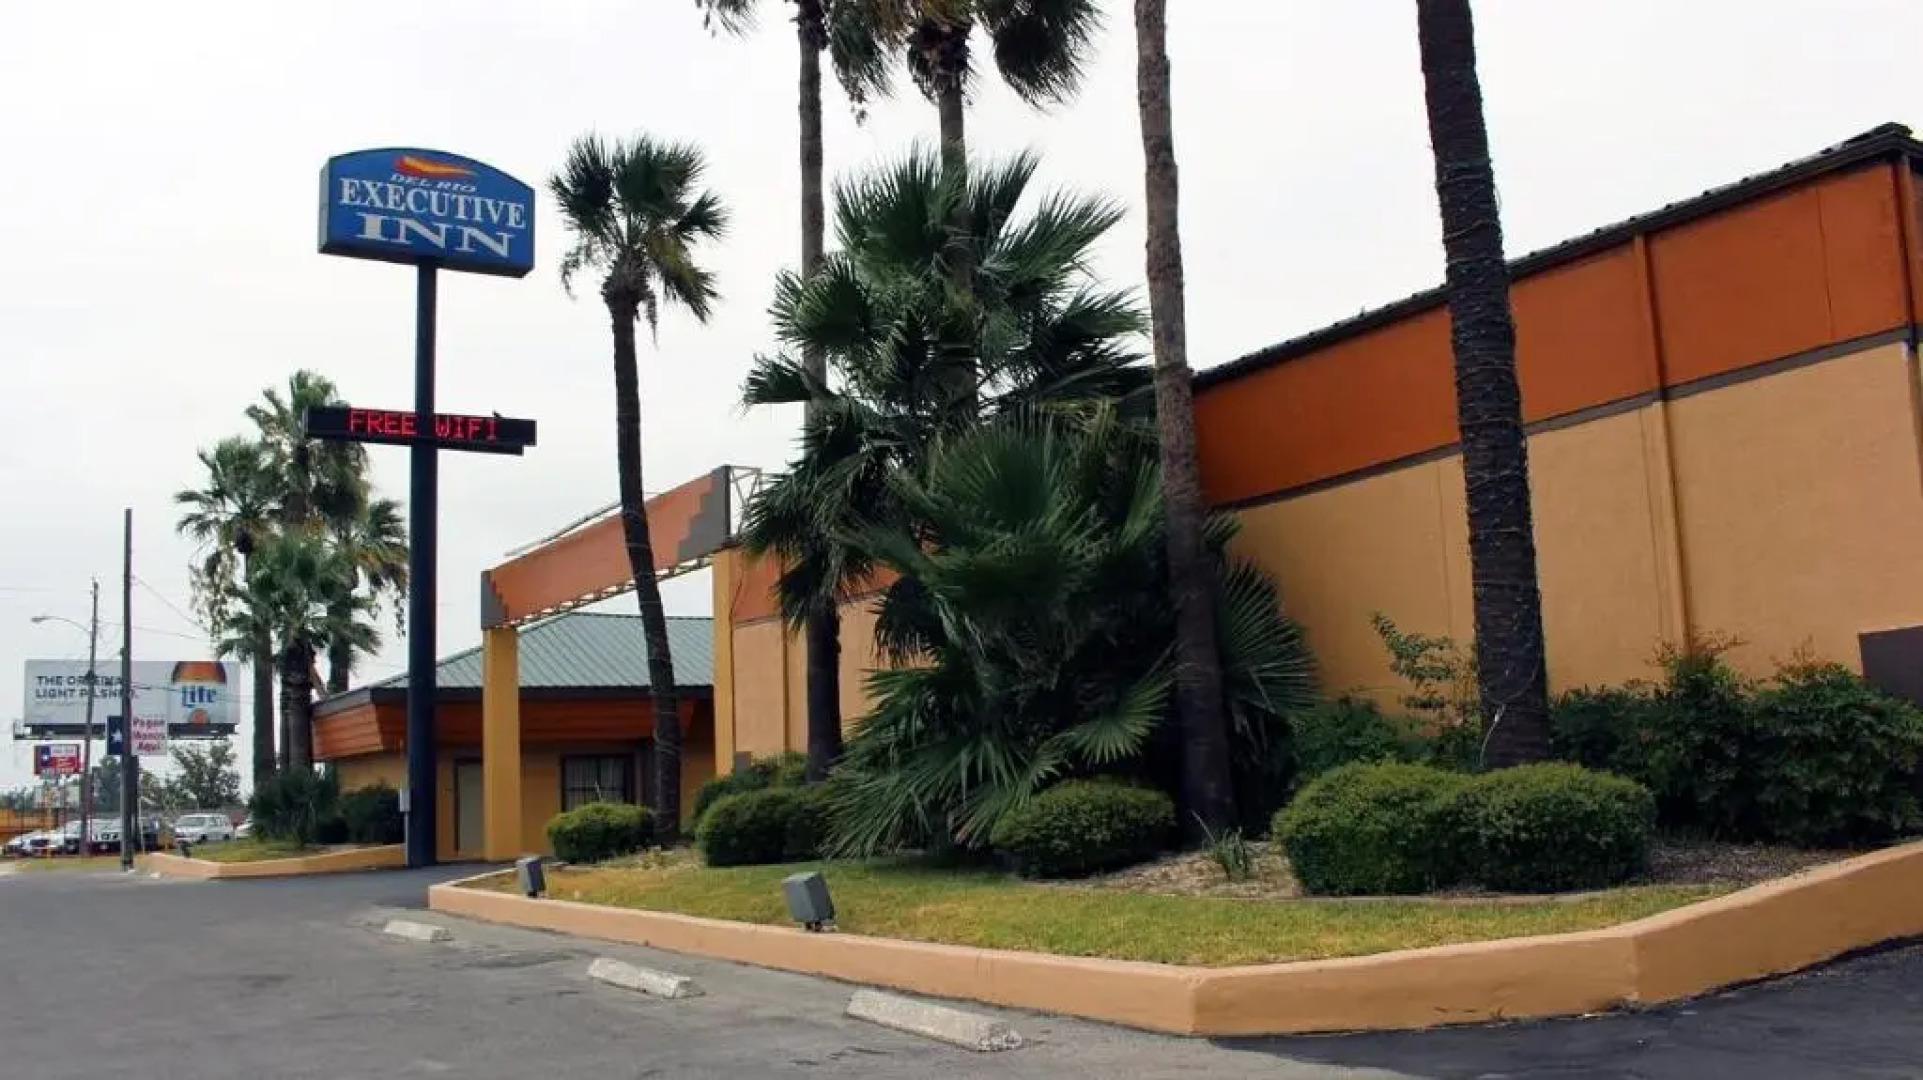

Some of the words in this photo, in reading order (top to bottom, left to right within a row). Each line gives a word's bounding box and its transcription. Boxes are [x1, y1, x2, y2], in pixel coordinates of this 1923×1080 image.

[390, 173, 432, 187] DEL
[437, 181, 477, 193] RIO
[339, 177, 526, 228] EXECUTIVE
[355, 211, 514, 258] INN
[349, 410, 418, 436] FREE
[434, 413, 498, 440] WIFI
[35, 688, 76, 698] LIGHT
[36, 675, 63, 686] THE
